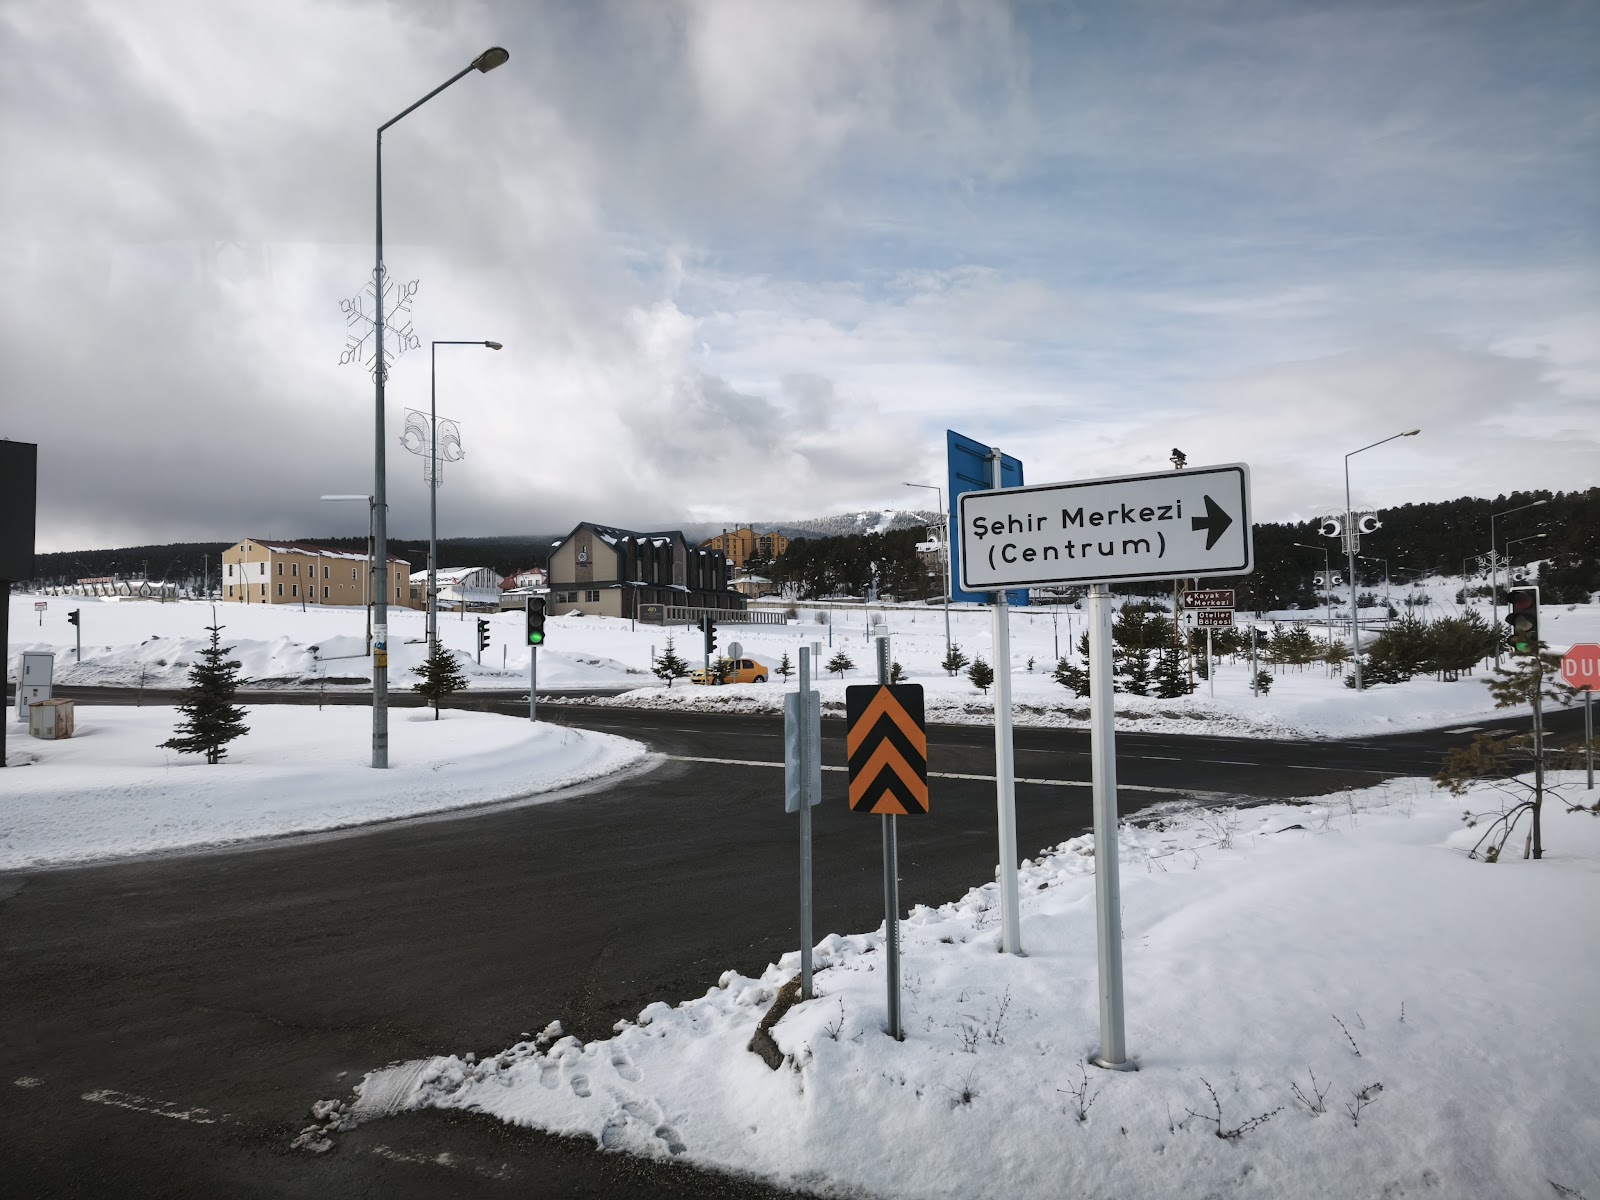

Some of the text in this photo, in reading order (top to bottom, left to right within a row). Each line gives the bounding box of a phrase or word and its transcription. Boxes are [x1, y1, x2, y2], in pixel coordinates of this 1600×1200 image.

[973, 499, 1183, 540] Şehir Merkezi
[988, 531, 1166, 570] (Centrum)
[1194, 592, 1220, 600] Kayak
